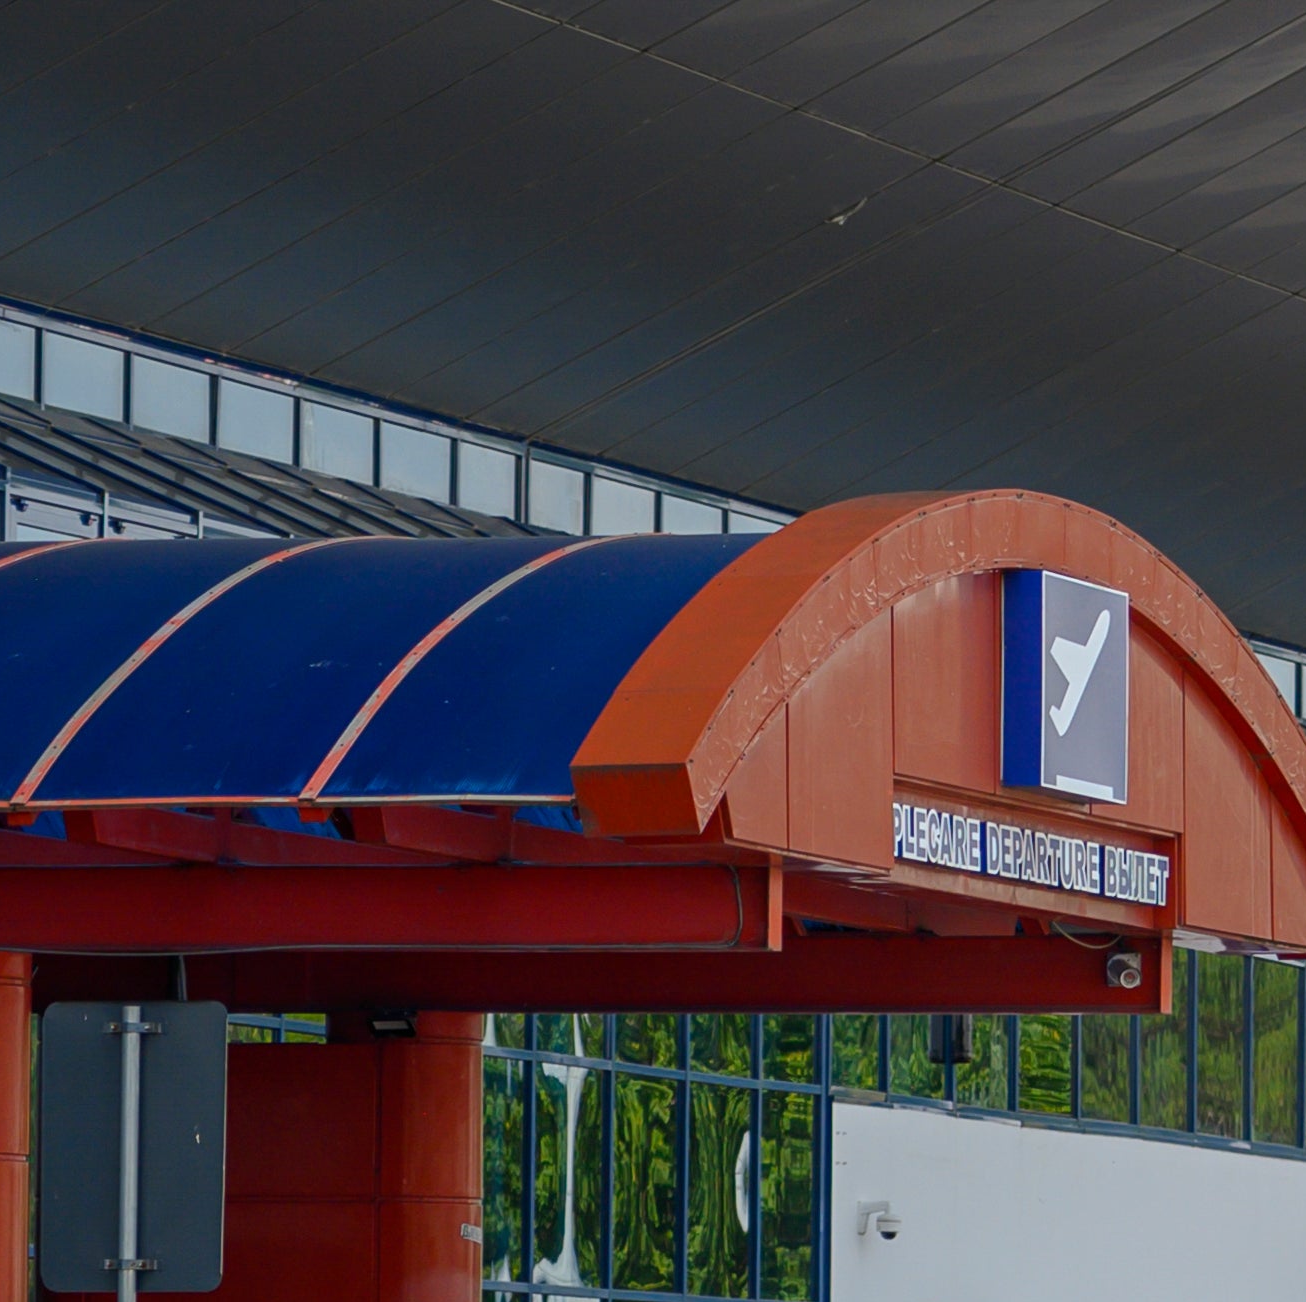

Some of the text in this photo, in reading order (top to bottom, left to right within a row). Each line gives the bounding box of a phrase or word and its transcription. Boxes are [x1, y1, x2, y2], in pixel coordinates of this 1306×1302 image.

[893, 803, 1100, 894] PLECARE DEPARTURE
[1104, 845, 1170, 907] ВЫЛЕТ
